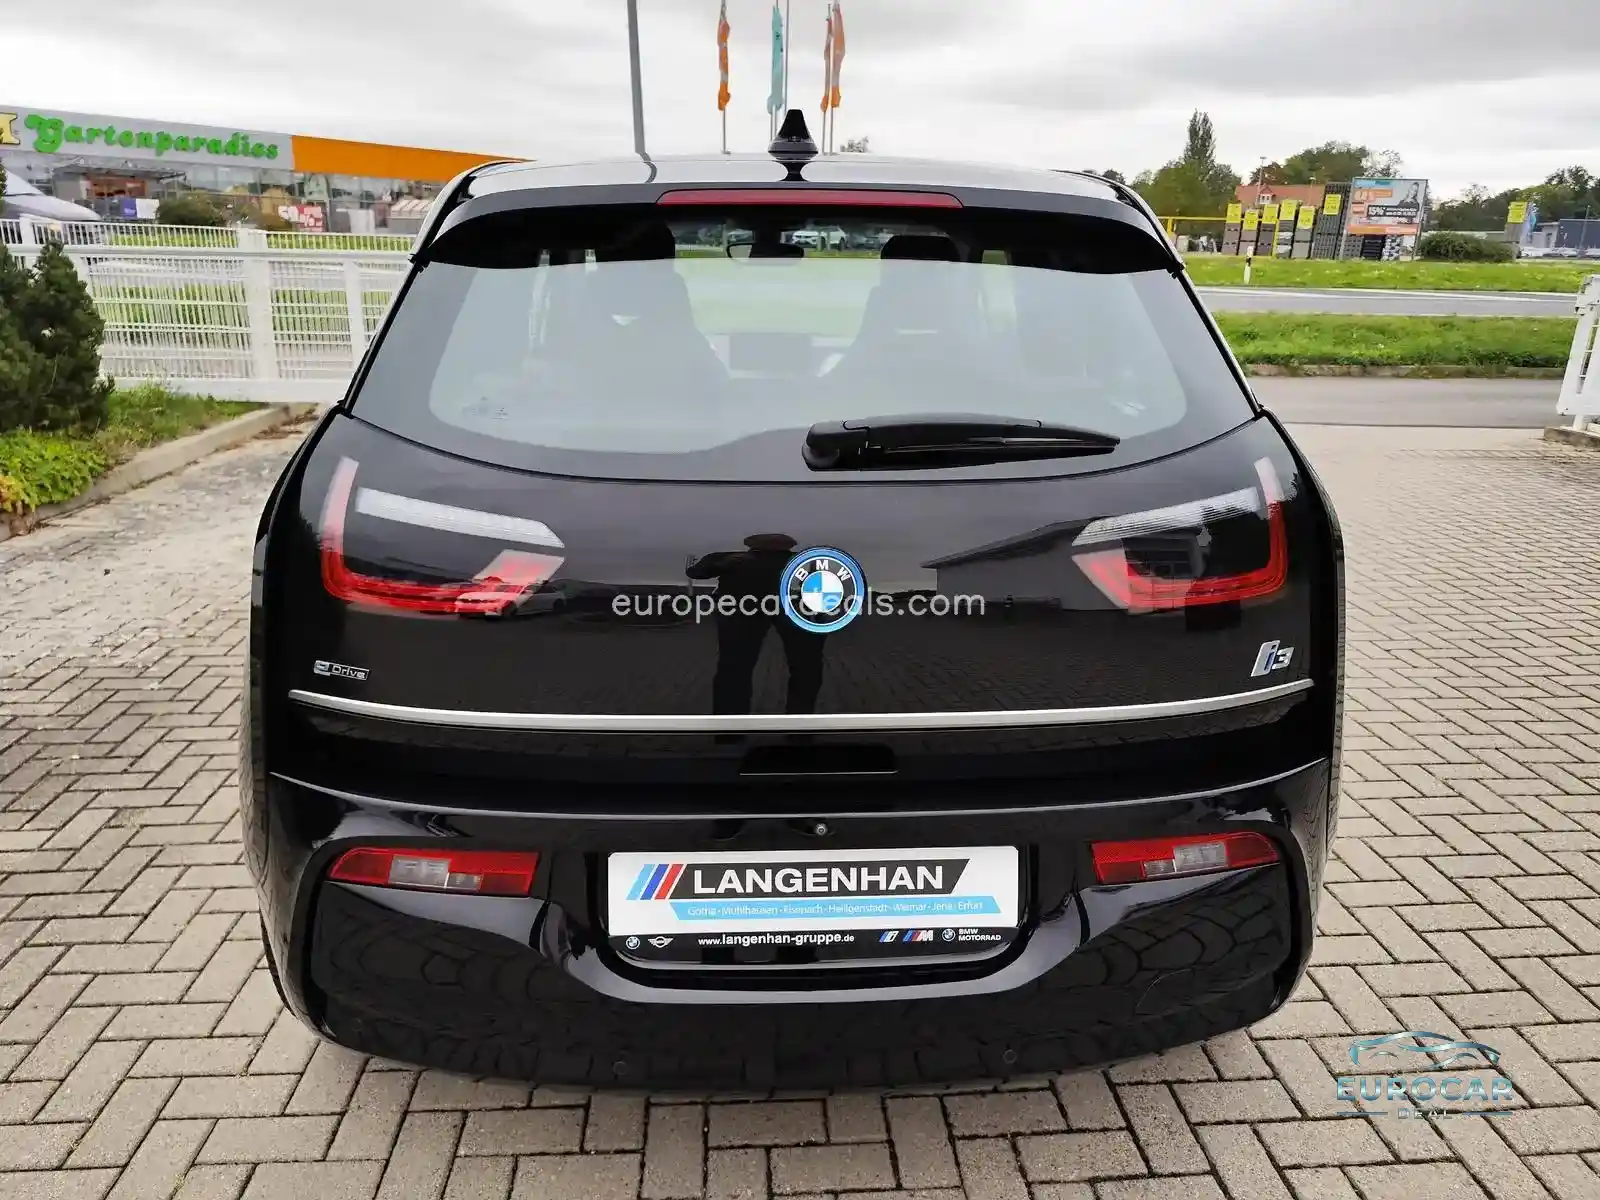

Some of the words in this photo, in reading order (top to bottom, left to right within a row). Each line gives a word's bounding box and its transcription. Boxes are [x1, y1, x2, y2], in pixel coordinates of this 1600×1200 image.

[24, 114, 279, 160] Gartenparadies
[795, 559, 851, 581] BMW
[1251, 640, 1295, 677] i3
[694, 865, 943, 894] LANGENHAN
[698, 932, 855, 947] www.langenhan-gruppe.de
[958, 933, 1002, 942] MOTORRAD
